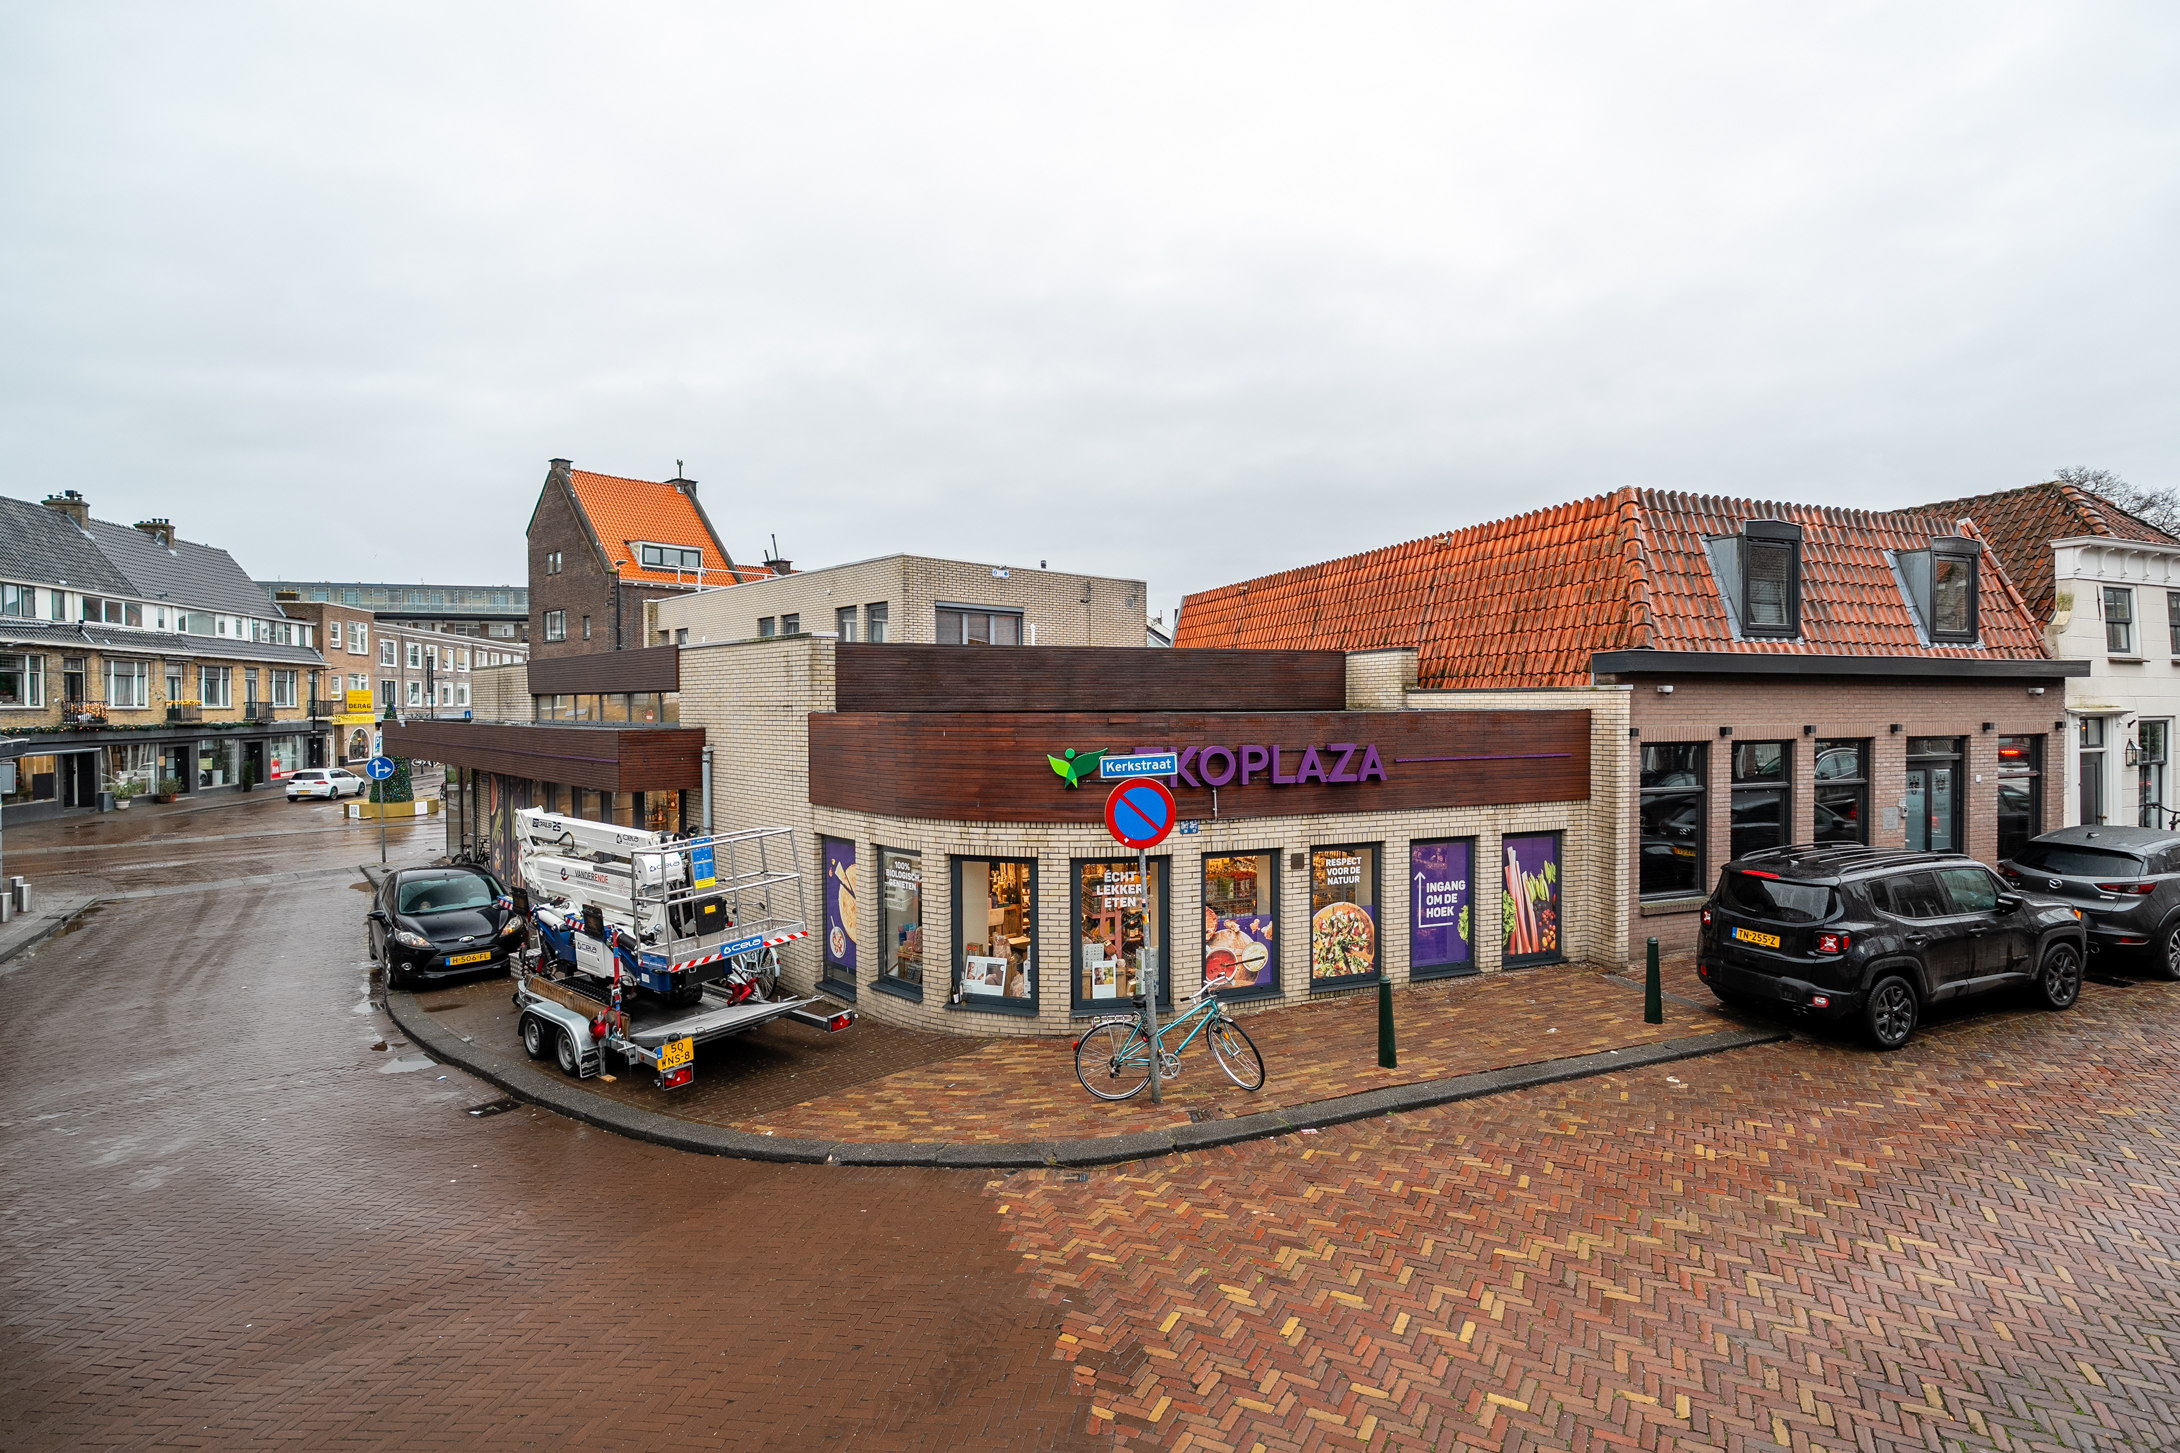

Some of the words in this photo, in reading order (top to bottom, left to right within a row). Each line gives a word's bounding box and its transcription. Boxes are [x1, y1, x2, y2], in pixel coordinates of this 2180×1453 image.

[1106, 759, 1172, 773] Kerkstraat
[1133, 743, 1388, 788] KOPLAZA
[552, 821, 562, 832] 25
[894, 860, 910, 871] 100%
[1325, 856, 1362, 867] RESPECT
[574, 869, 610, 884] VANDERENDE
[885, 868, 920, 882] BIOLOGISCH
[1103, 869, 1137, 883] ÉCHT
[1326, 867, 1349, 876] VOOR
[1350, 866, 1361, 875] DE
[888, 878, 917, 891] GENIETEN
[1327, 875, 1361, 886] NATUUR
[1426, 880, 1466, 893] INGANG
[1096, 884, 1143, 896] LEKKER
[1104, 896, 1137, 908] ETEN
[1426, 895, 1443, 906] OM
[1444, 893, 1458, 904] DE
[1426, 906, 1455, 918] HOEK
[1738, 929, 1776, 946] TN-255-Z
[452, 953, 489, 964] H-506-FL
